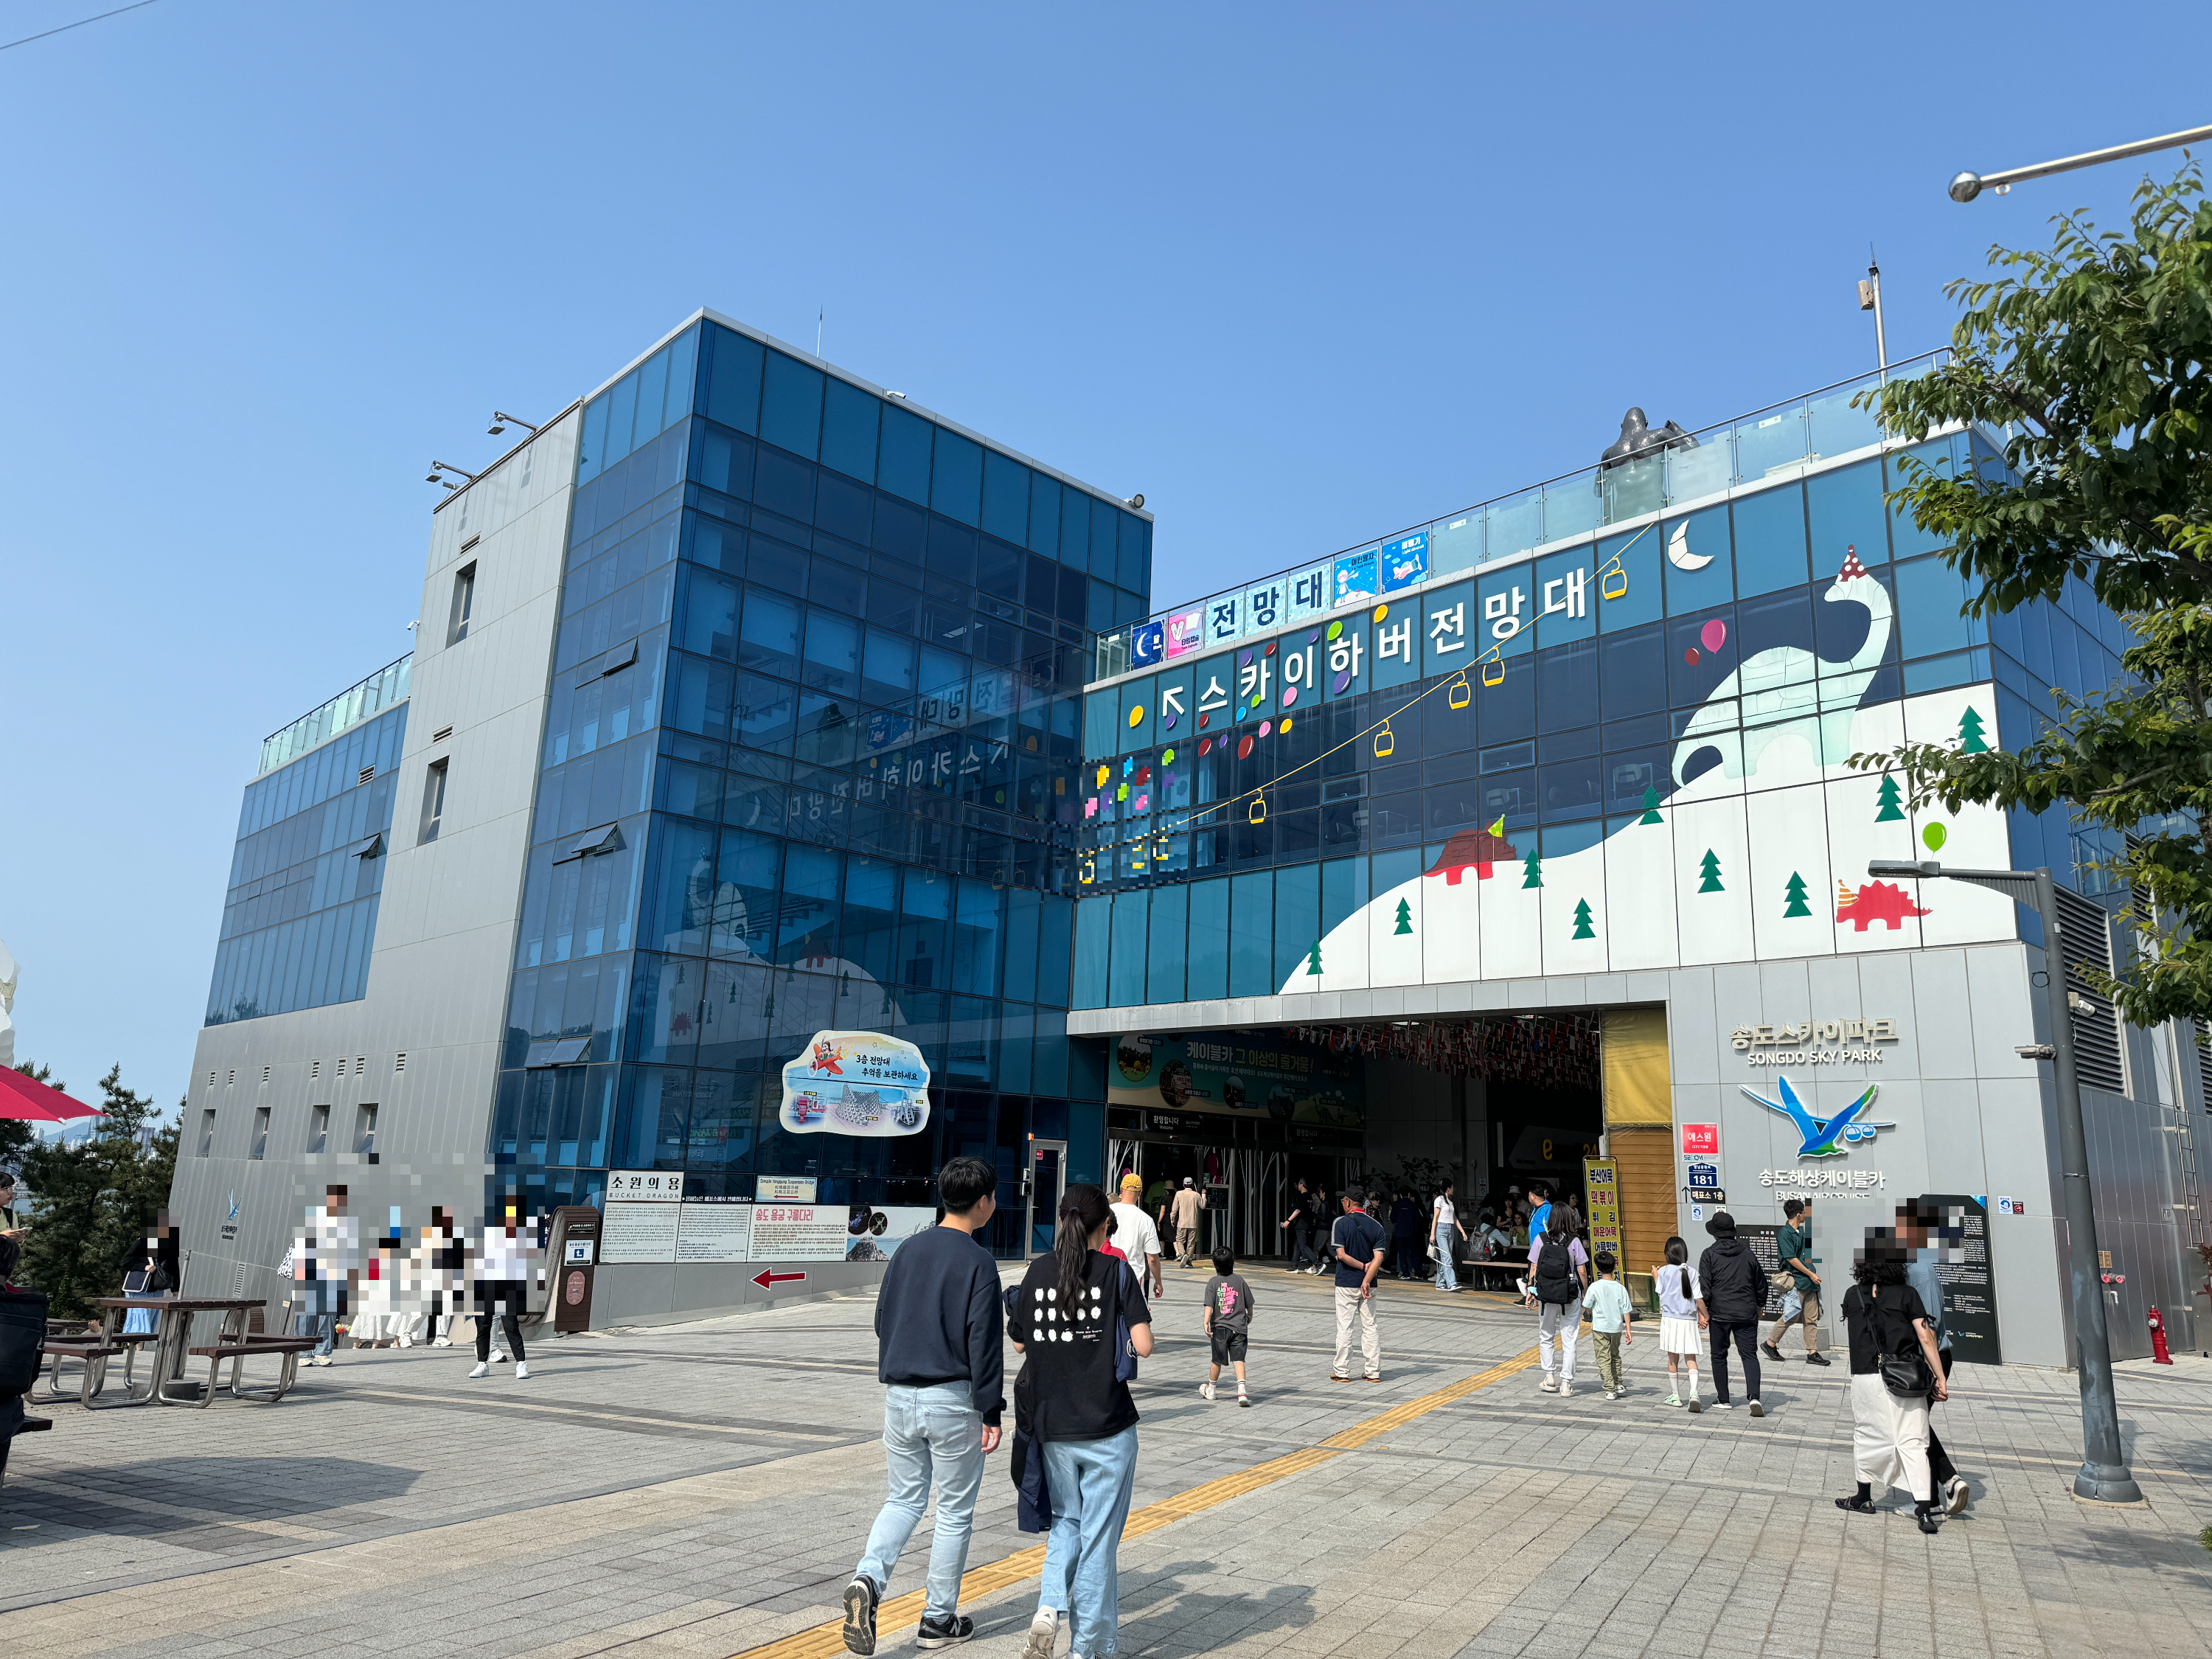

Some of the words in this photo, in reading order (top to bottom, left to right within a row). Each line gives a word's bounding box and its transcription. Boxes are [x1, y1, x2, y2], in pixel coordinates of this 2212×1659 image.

[1351, 552, 1374, 566] 어린왕자
[1212, 571, 1323, 639] 전망대
[1181, 635, 1200, 646] 타임캡슐
[1730, 1018, 1899, 1050] 송도스카이파크
[856, 1055, 869, 1065] 3층
[869, 1056, 891, 1066] 전망대
[1186, 1041, 1234, 1063] 케이블카
[1235, 1048, 1246, 1065] 그
[1248, 1049, 1278, 1069] 이상의
[1280, 1053, 1315, 1074] 즐거움!
[1747, 1051, 1806, 1065] SONGDO
[1809, 1050, 1837, 1063] SKY
[1842, 1048, 1882, 1062] PARK
[1204, 1064, 1219, 1072] 즐거움이
[862, 1068, 882, 1078] 추억을
[883, 1070, 918, 1081] 보관하세요
[1153, 1115, 1179, 1125] 환영합니다
[1688, 1132, 1711, 1142] 에스원
[1590, 1168, 1613, 1184] 부산어묵
[1693, 1175, 1713, 1185] 181
[1759, 1169, 1886, 1189] 송도해상케이블카
[1590, 1190, 1615, 1206] 떡볶이
[1692, 1190, 1711, 1200] 매표소
[1713, 1191, 1724, 1201] 1층
[1775, 1191, 1810, 1200] BUSAN
[756, 1208, 769, 1221] 송도
[771, 1208, 785, 1221] 용궁
[787, 1208, 814, 1221] 구름다리
[1593, 1226, 1617, 1237] 매운어묵
[1594, 1241, 1618, 1252] 어묵핫바
